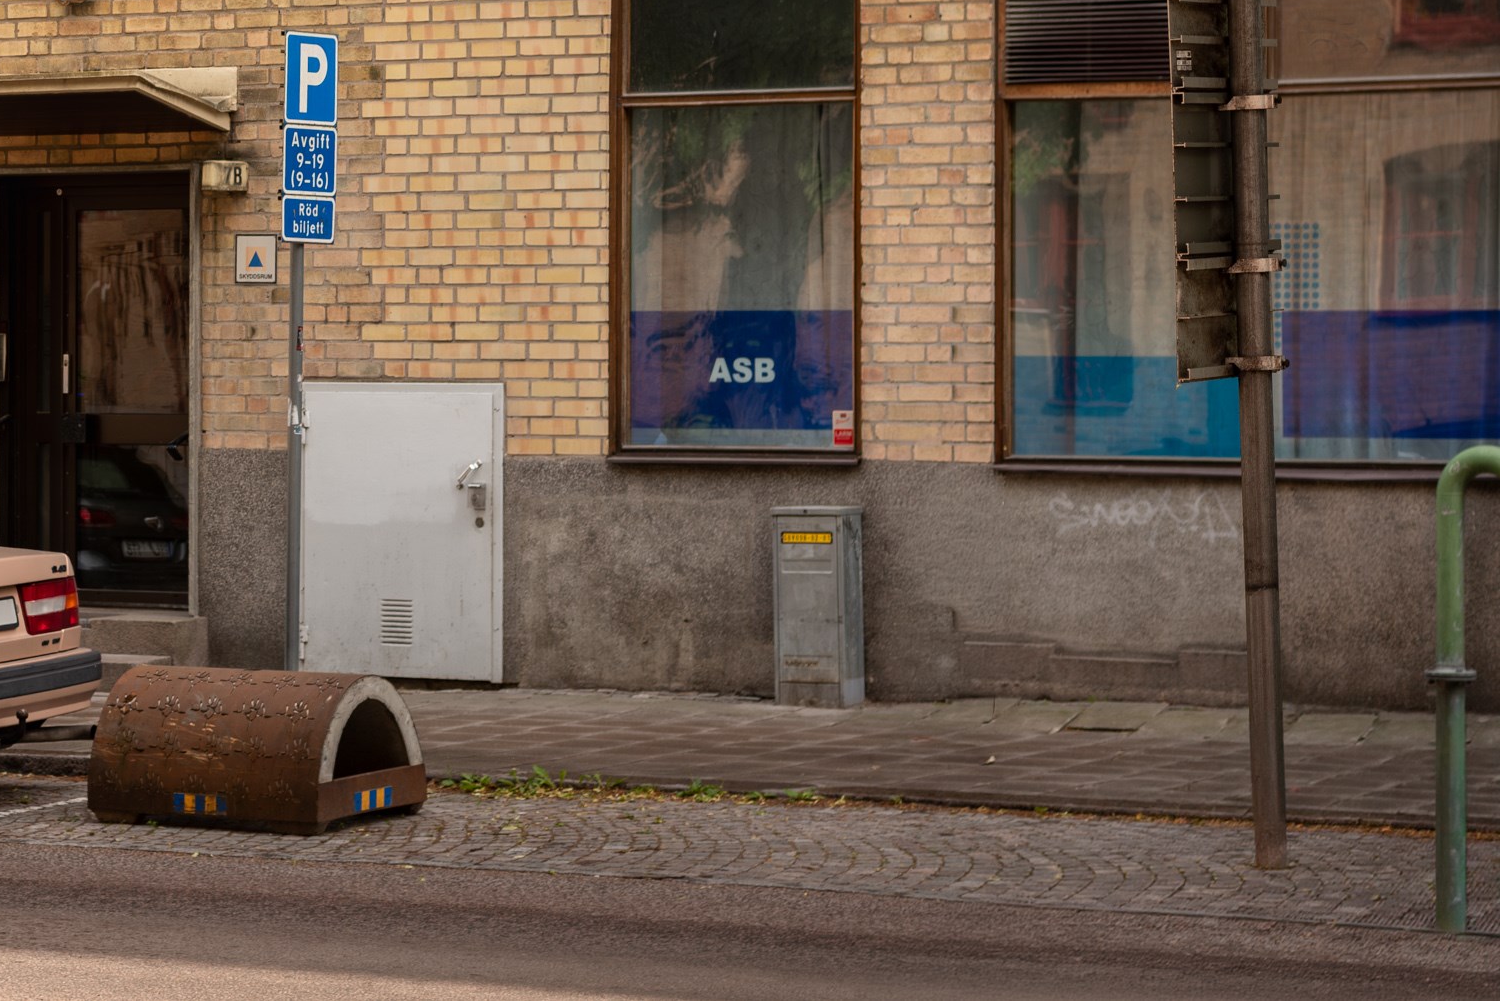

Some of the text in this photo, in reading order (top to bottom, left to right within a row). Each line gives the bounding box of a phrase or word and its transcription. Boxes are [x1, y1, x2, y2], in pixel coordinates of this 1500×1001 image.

[299, 42, 328, 114] P
[291, 132, 330, 152] Avgift
[296, 153, 325, 169] 9-19
[224, 166, 242, 186] 7B
[291, 170, 329, 190] (9-16)
[299, 202, 319, 217] Röd
[293, 220, 324, 237] biljett
[708, 357, 776, 383] ASB
